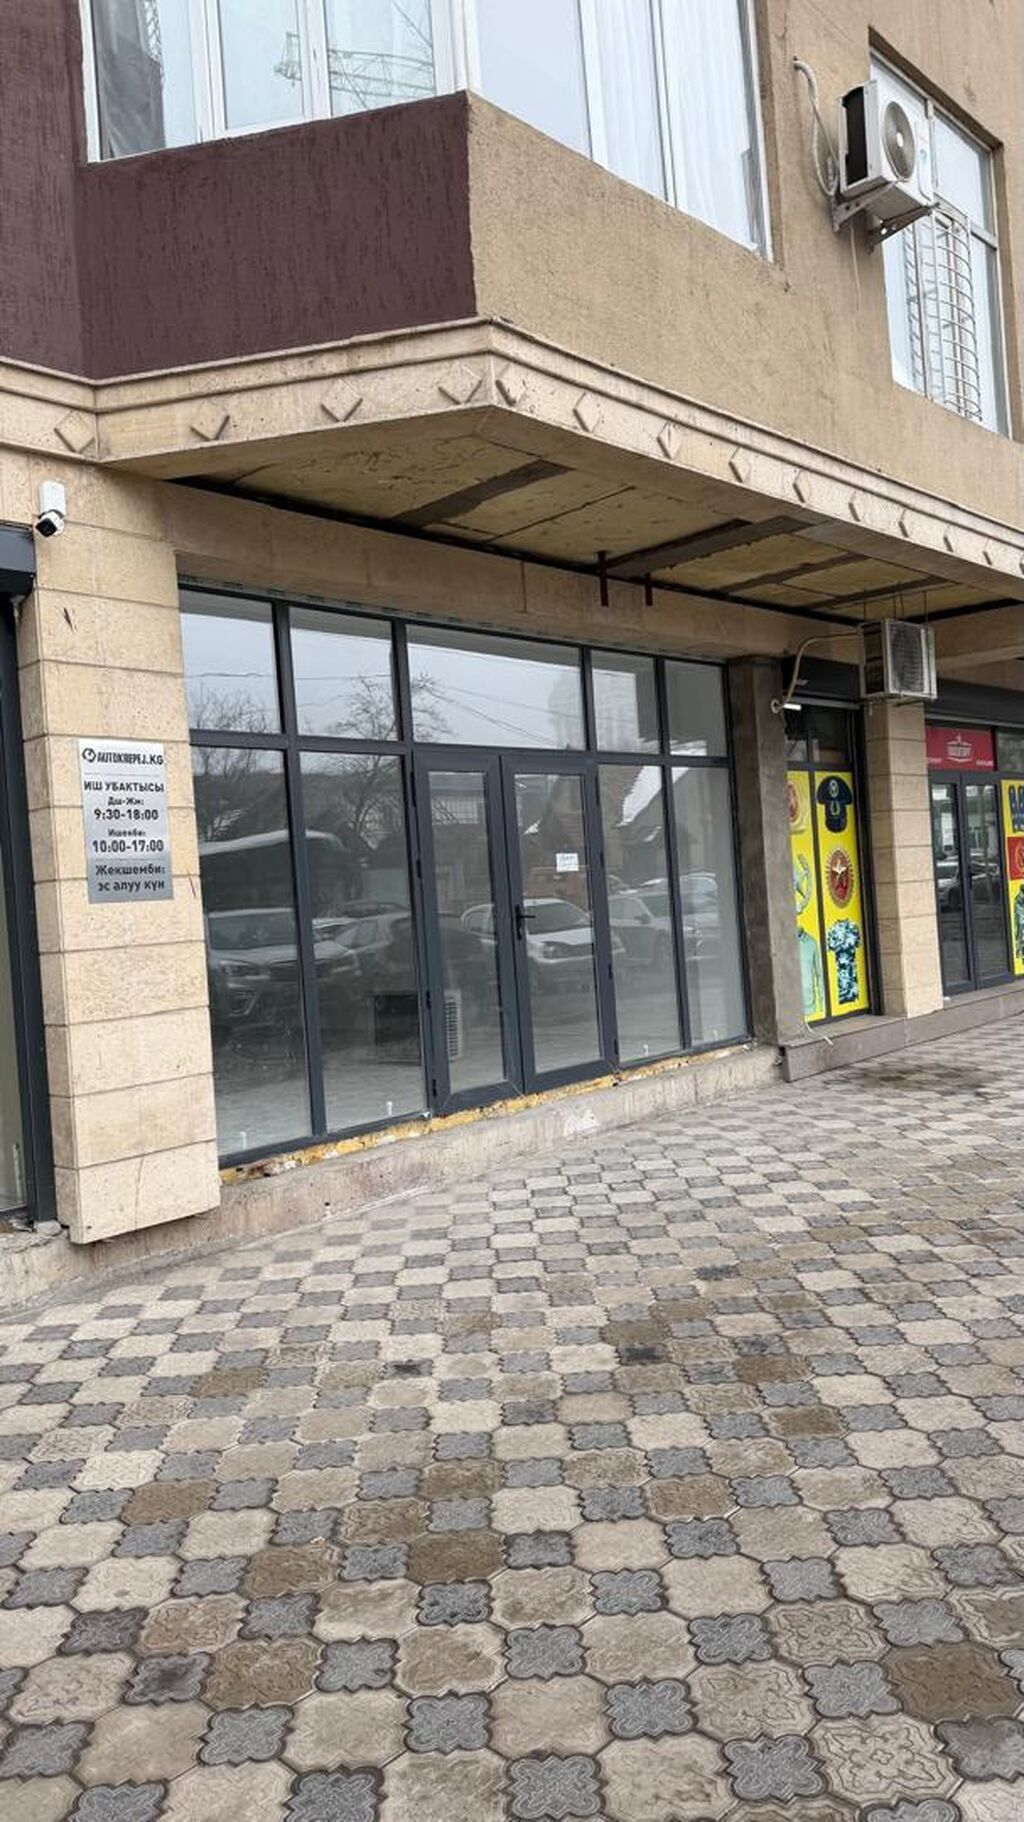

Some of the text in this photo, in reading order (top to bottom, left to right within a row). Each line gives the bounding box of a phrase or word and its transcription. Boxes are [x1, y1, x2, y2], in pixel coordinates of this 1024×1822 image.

[84, 781, 164, 792] ИШ УБАКТЫСЫ
[94, 808, 159, 820] 9:30-18:00
[92, 839, 164, 853] 10:00-17:00
[95, 863, 166, 875] Жекшемби:
[97, 881, 111, 892] эс
[113, 881, 141, 893] алуу
